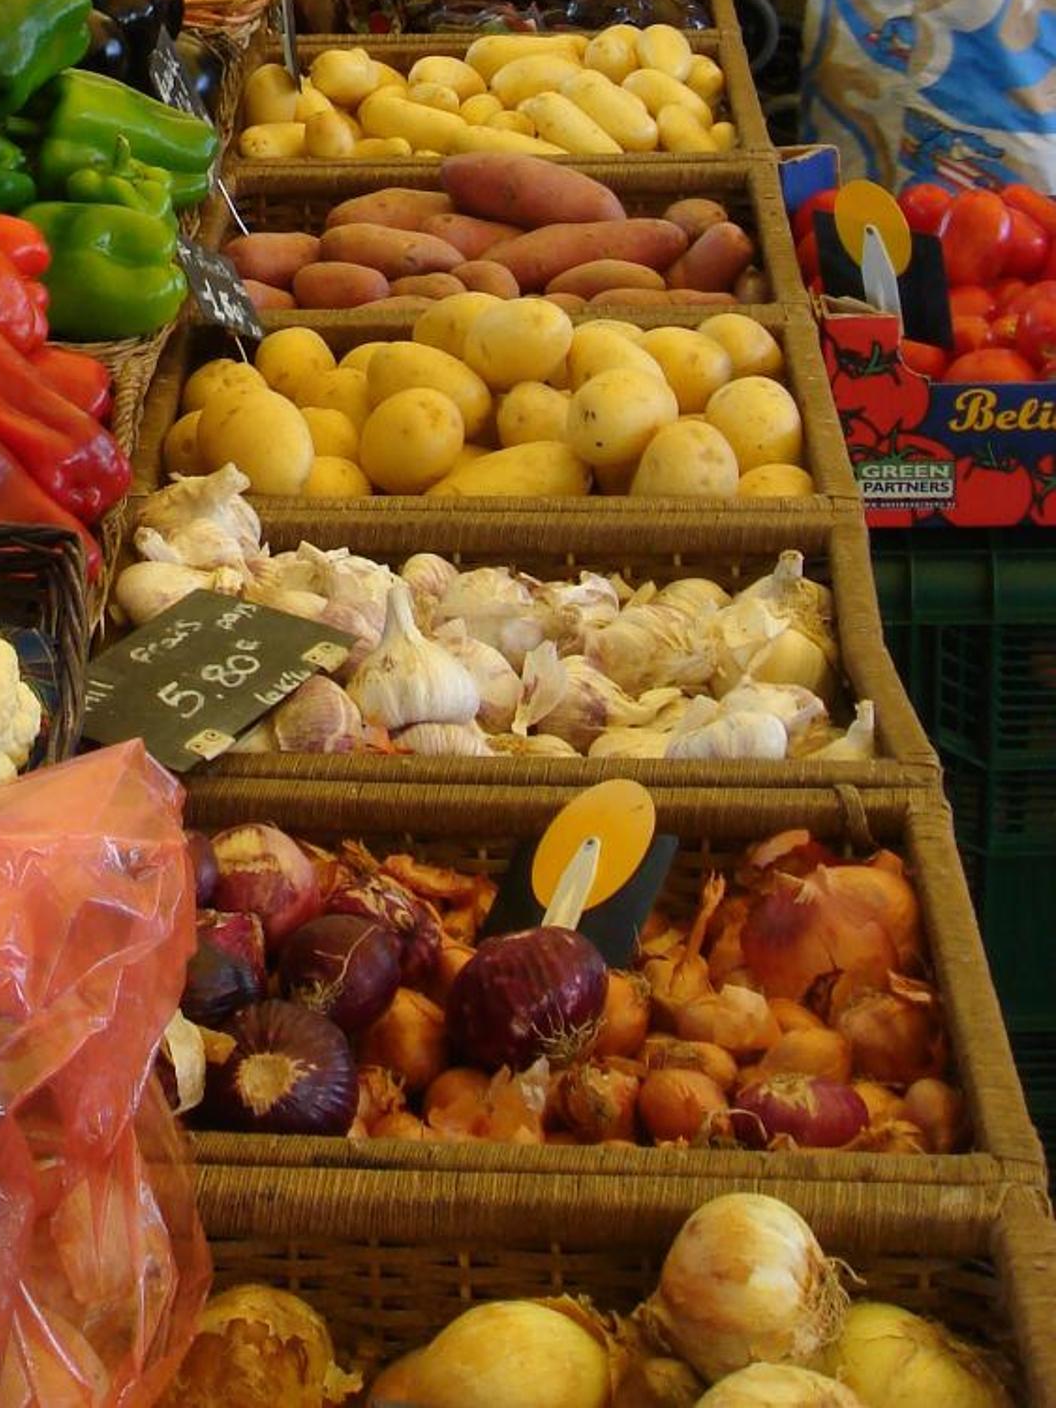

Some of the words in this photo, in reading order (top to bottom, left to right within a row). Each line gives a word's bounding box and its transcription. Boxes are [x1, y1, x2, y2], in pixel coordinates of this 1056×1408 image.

[949, 388, 1056, 431] Beli
[862, 464, 950, 479] GREEN
[863, 481, 950, 493] PARTNERS
